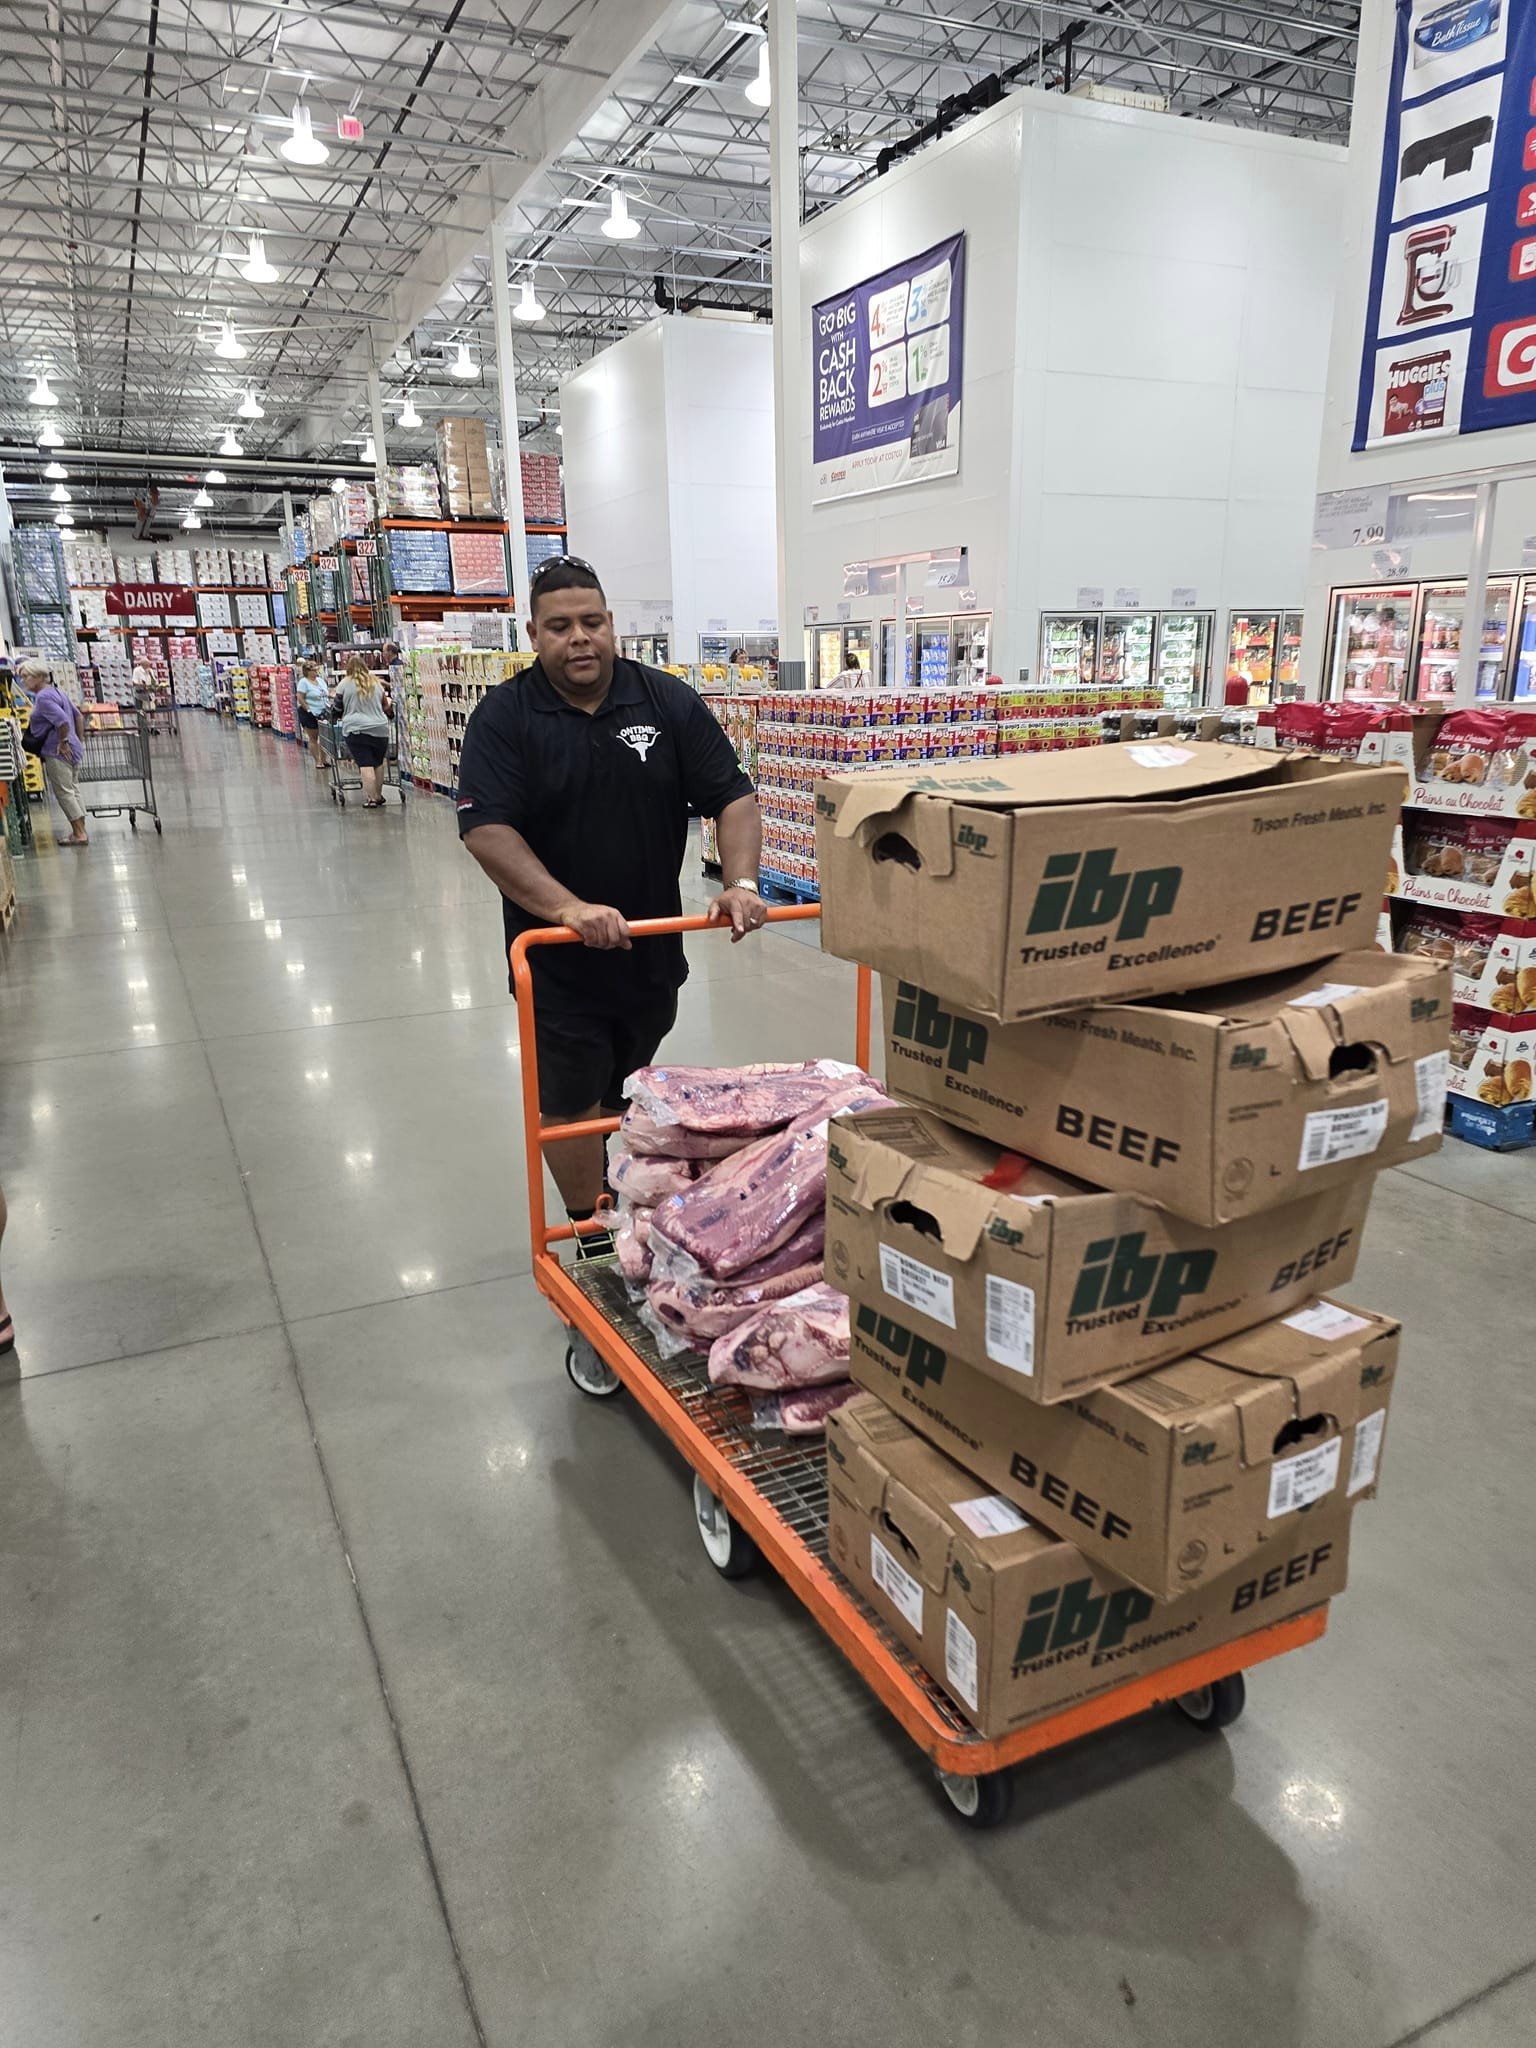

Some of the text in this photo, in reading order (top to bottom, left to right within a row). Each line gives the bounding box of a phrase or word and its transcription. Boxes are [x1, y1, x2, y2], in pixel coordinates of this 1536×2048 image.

[819, 312, 835, 336] GO
[836, 302, 856, 329] BIG
[830, 331, 844, 343] WITH
[819, 337, 856, 376] CASH
[819, 366, 856, 404] BACK
[1387, 360, 1452, 390] HUGGIES
[819, 396, 856, 422] REWARDS
[358, 541, 375, 555] 322
[1352, 526, 1384, 543] 7.99
[294, 571, 309, 581] 326
[321, 559, 338, 570] 324
[123, 591, 174, 609] DAIRY
[630, 734, 649, 742] BBQ
[1414, 788, 1505, 811] Pains au Chocolat
[957, 823, 988, 851] ibp
[1252, 817, 1289, 835] Tyson
[1291, 811, 1327, 827] Fresh
[1025, 848, 1183, 942] ibp
[1402, 880, 1493, 909] Pains au Chocolat
[1250, 893, 1362, 943] BEEF
[1019, 936, 1107, 965] Trusted
[892, 980, 988, 1074] ibp
[1080, 1020, 1118, 1040] Fresh
[1170, 1041, 1197, 1062] Inc.
[891, 1040, 943, 1069] Trusted
[944, 1075, 1025, 1118] Excellence
[1055, 1104, 1182, 1169] BEEF
[1067, 1229, 1353, 1319] ibp BEEF
[1065, 1304, 1141, 1336] Trusted
[854, 1334, 902, 1379] Trusted
[1009, 1451, 1134, 1542] BEEF
[1231, 1541, 1333, 1615] BEEF
[1013, 1577, 1155, 1664] ibp
[1010, 1641, 1090, 1681] Trusted
